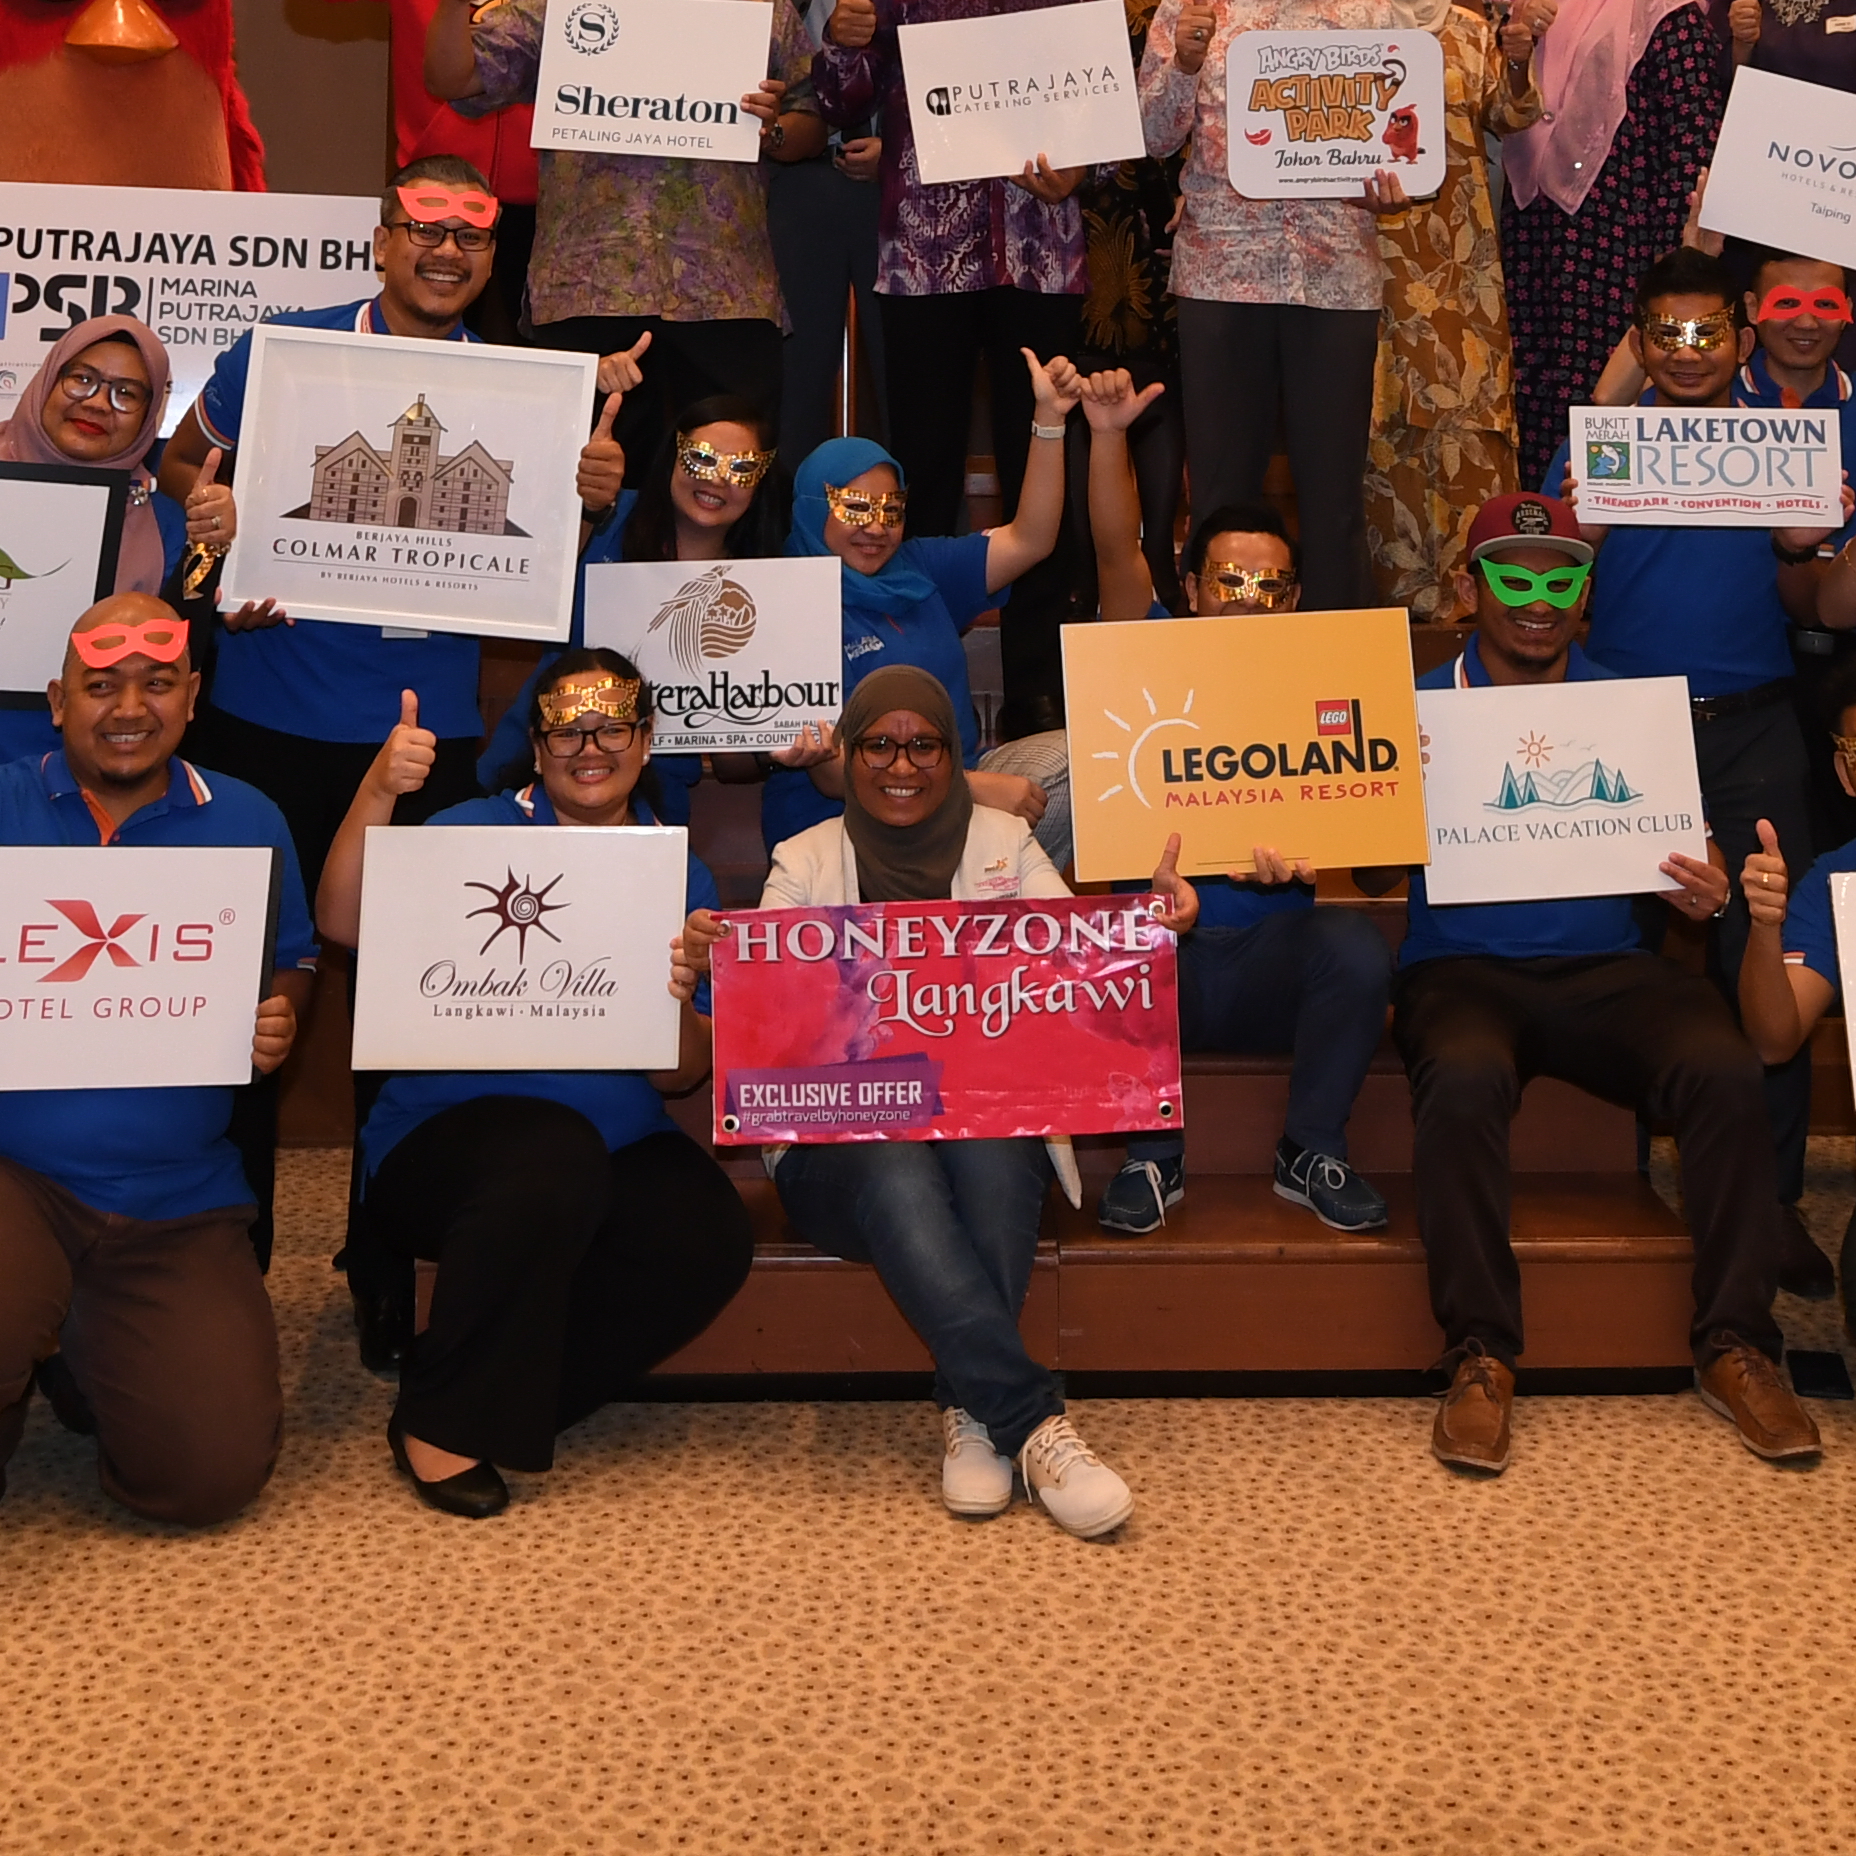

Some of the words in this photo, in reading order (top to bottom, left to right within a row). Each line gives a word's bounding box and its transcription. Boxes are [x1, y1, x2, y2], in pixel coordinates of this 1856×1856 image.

[1257, 45, 1323, 74] ANGRY
[1322, 44, 1383, 71] BIRDS
[952, 65, 1116, 102] PUTRAJAYA
[1248, 70, 1402, 111] ACTIVITY
[554, 84, 740, 126] Sheraton
[953, 96, 1032, 114] CATERING
[1043, 82, 1121, 103] SERVICES
[1285, 108, 1375, 142] PARK
[551, 127, 622, 143] PETALING
[625, 132, 662, 146] JAYA
[666, 135, 714, 150] HOTEL
[1274, 149, 1323, 169] Johor
[1326, 148, 1384, 166] Bahru
[1781, 171, 1826, 190] HOTELS
[1810, 201, 1852, 225] Taiping
[227, 235, 310, 270] SDN
[160, 278, 257, 298] MARINA
[157, 326, 206, 345] SDN
[213, 328, 245, 346] BH
[1584, 417, 1630, 430] BUKIT
[1585, 430, 1630, 441] MERAH
[1636, 416, 1827, 444] LAKETOWN
[1636, 445, 1828, 487] RESORT
[1680, 498, 1762, 510] CONVENTION
[1776, 497, 1821, 510] HOTELS
[356, 530, 410, 545] BERJAYA
[416, 534, 452, 547] HILLS
[272, 537, 378, 563] COLMAR
[391, 547, 531, 575] TROPICALE
[320, 571, 332, 579] BY
[337, 573, 378, 584] BERJAYA
[382, 576, 420, 587] HOTELS
[435, 580, 480, 592] RESORTS
[773, 720, 801, 729] SABAH
[1319, 710, 1348, 726] LEGO
[674, 735, 717, 745] MARINA
[726, 734, 747, 744] SPA
[1162, 698, 1399, 783] LEGOLAND
[1165, 787, 1285, 809] MALAYSIA
[1300, 781, 1400, 801] RESORT
[1436, 824, 1521, 846] PALACE
[1525, 816, 1632, 842] VACATION
[1636, 813, 1693, 834] CLUB
[734, 908, 1154, 963] HONEYZONE
[419, 959, 530, 999] Ombak
[539, 955, 621, 1000] Villa
[92, 996, 208, 1019] GROUP
[433, 1003, 515, 1020] Langkawi
[530, 1003, 607, 1021] Malaysia
[866, 963, 1154, 1039] Langkawi
[739, 1082, 852, 1108] EXCLUSIVE
[858, 1080, 923, 1106] OFFER
[743, 1108, 911, 1127] #grabtravelbyhoneyzone
